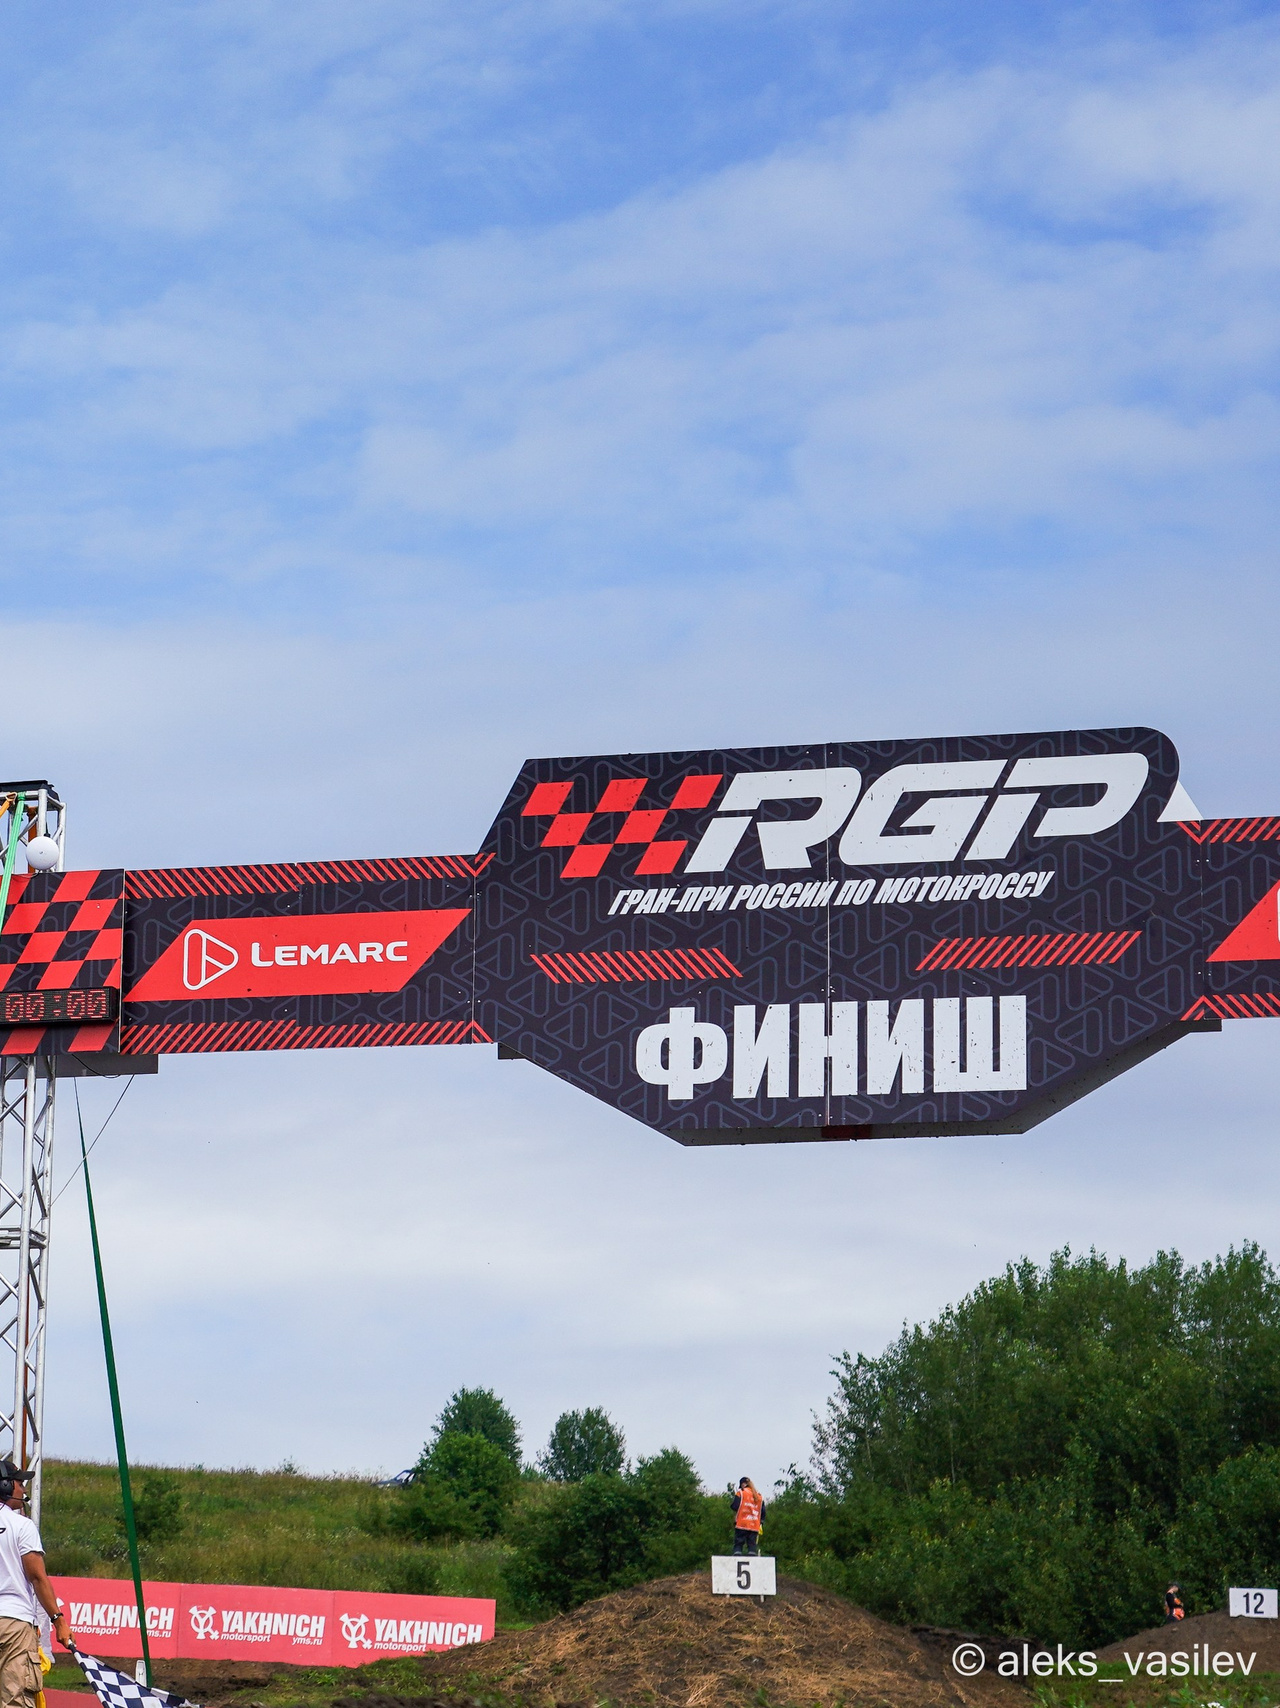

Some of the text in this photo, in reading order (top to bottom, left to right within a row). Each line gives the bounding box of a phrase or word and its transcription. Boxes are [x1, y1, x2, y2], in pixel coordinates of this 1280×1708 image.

[683, 752, 1150, 873] RGP
[607, 870, 1056, 916] ГРАН-ПРИ РОССИИ ПО МОТОКРОССУ
[251, 940, 408, 968] LEMARC
[635, 995, 1027, 1100] ФИНИШ
[736, 1561, 751, 1590] 5
[69, 1602, 175, 1630] YAKHNCH
[1242, 1592, 1265, 1615] 12
[69, 1625, 172, 1638] motorsport ms.ru
[221, 1610, 326, 1638] YAKHNICH
[374, 1618, 483, 1646] YAKHNICH
[220, 1632, 323, 1646] motorsport yms.ru
[373, 1641, 426, 1653] motorsport
